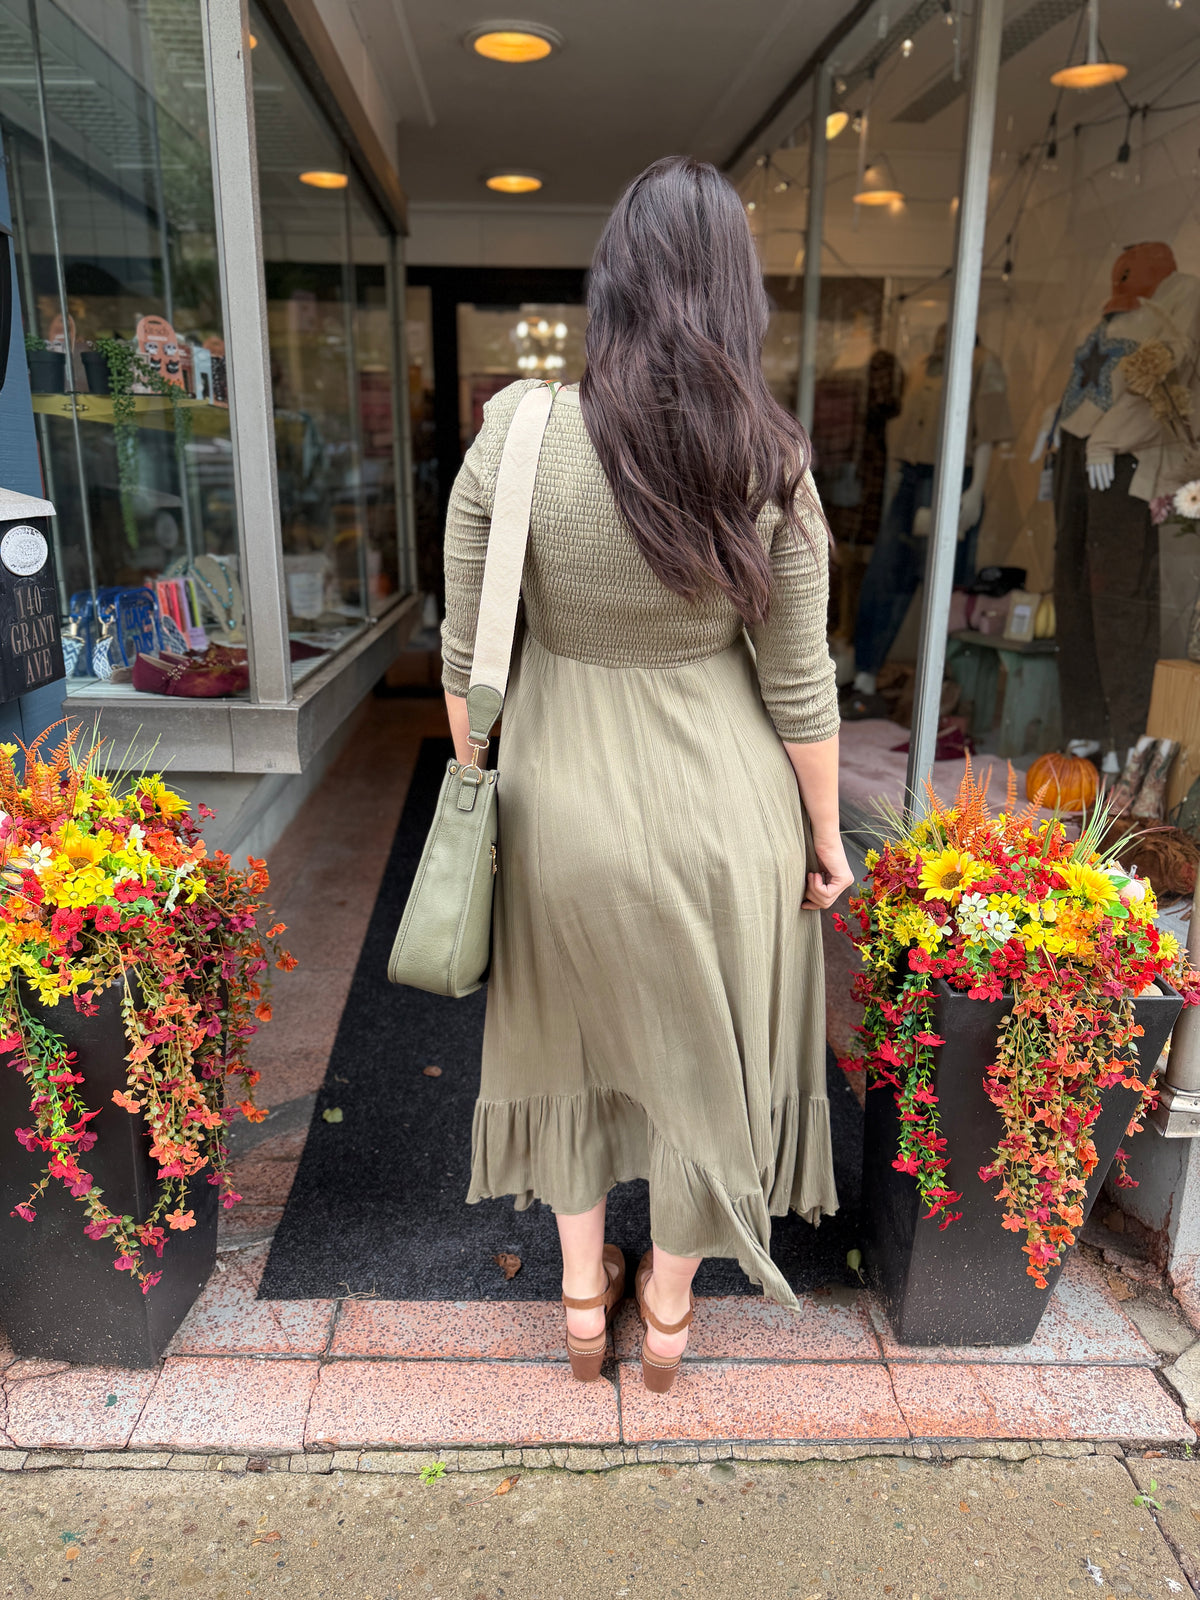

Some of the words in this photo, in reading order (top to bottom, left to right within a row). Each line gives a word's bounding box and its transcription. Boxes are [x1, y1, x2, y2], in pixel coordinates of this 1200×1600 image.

[16, 585, 42, 619] 140
[11, 614, 55, 655] GRANT
[26, 648, 53, 684] AVE
